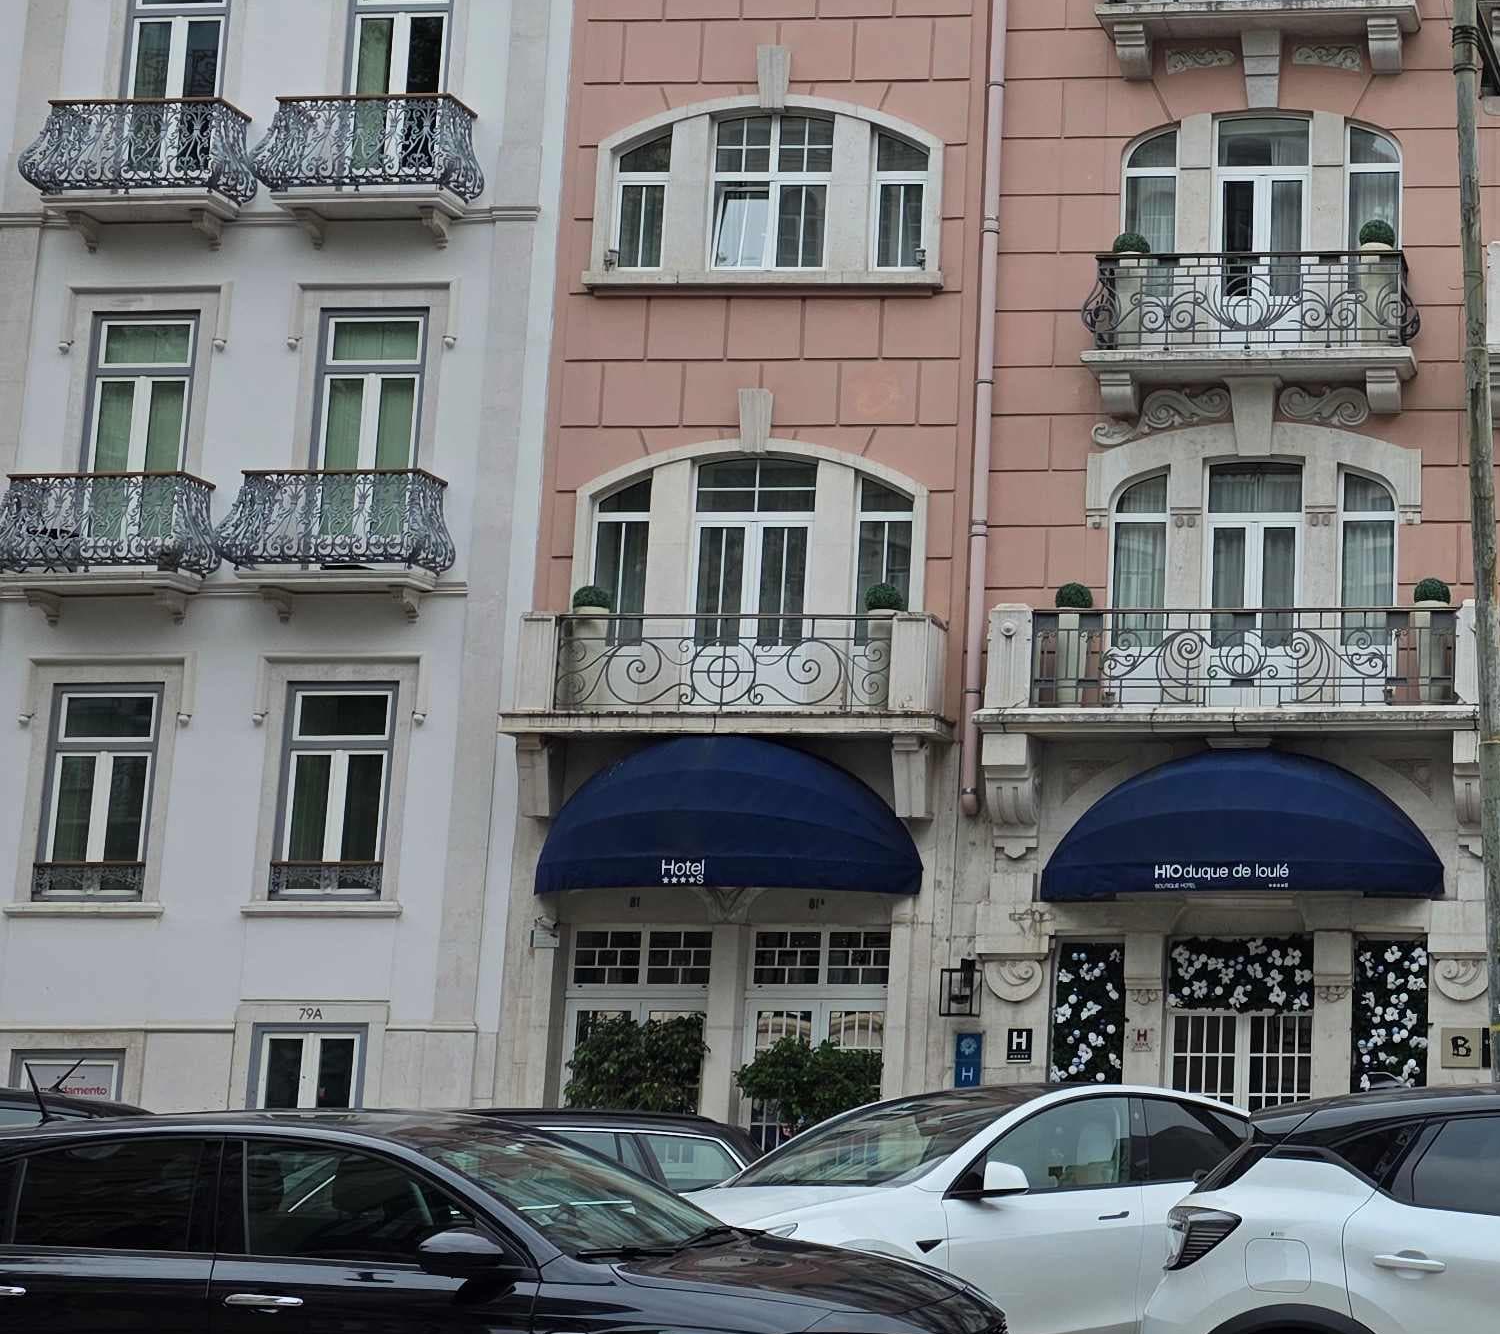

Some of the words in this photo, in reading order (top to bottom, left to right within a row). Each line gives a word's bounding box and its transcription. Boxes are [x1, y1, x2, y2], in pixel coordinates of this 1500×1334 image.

[661, 859, 705, 876] Hotel
[1154, 864, 1182, 879] H10
[1183, 864, 1229, 881] duque
[1232, 864, 1252, 878] de
[1255, 863, 1290, 878] loulé
[299, 1007, 323, 1020] 79A
[1012, 1031, 1027, 1050] H
[1136, 1028, 1148, 1042] H
[961, 1066, 974, 1082] H
